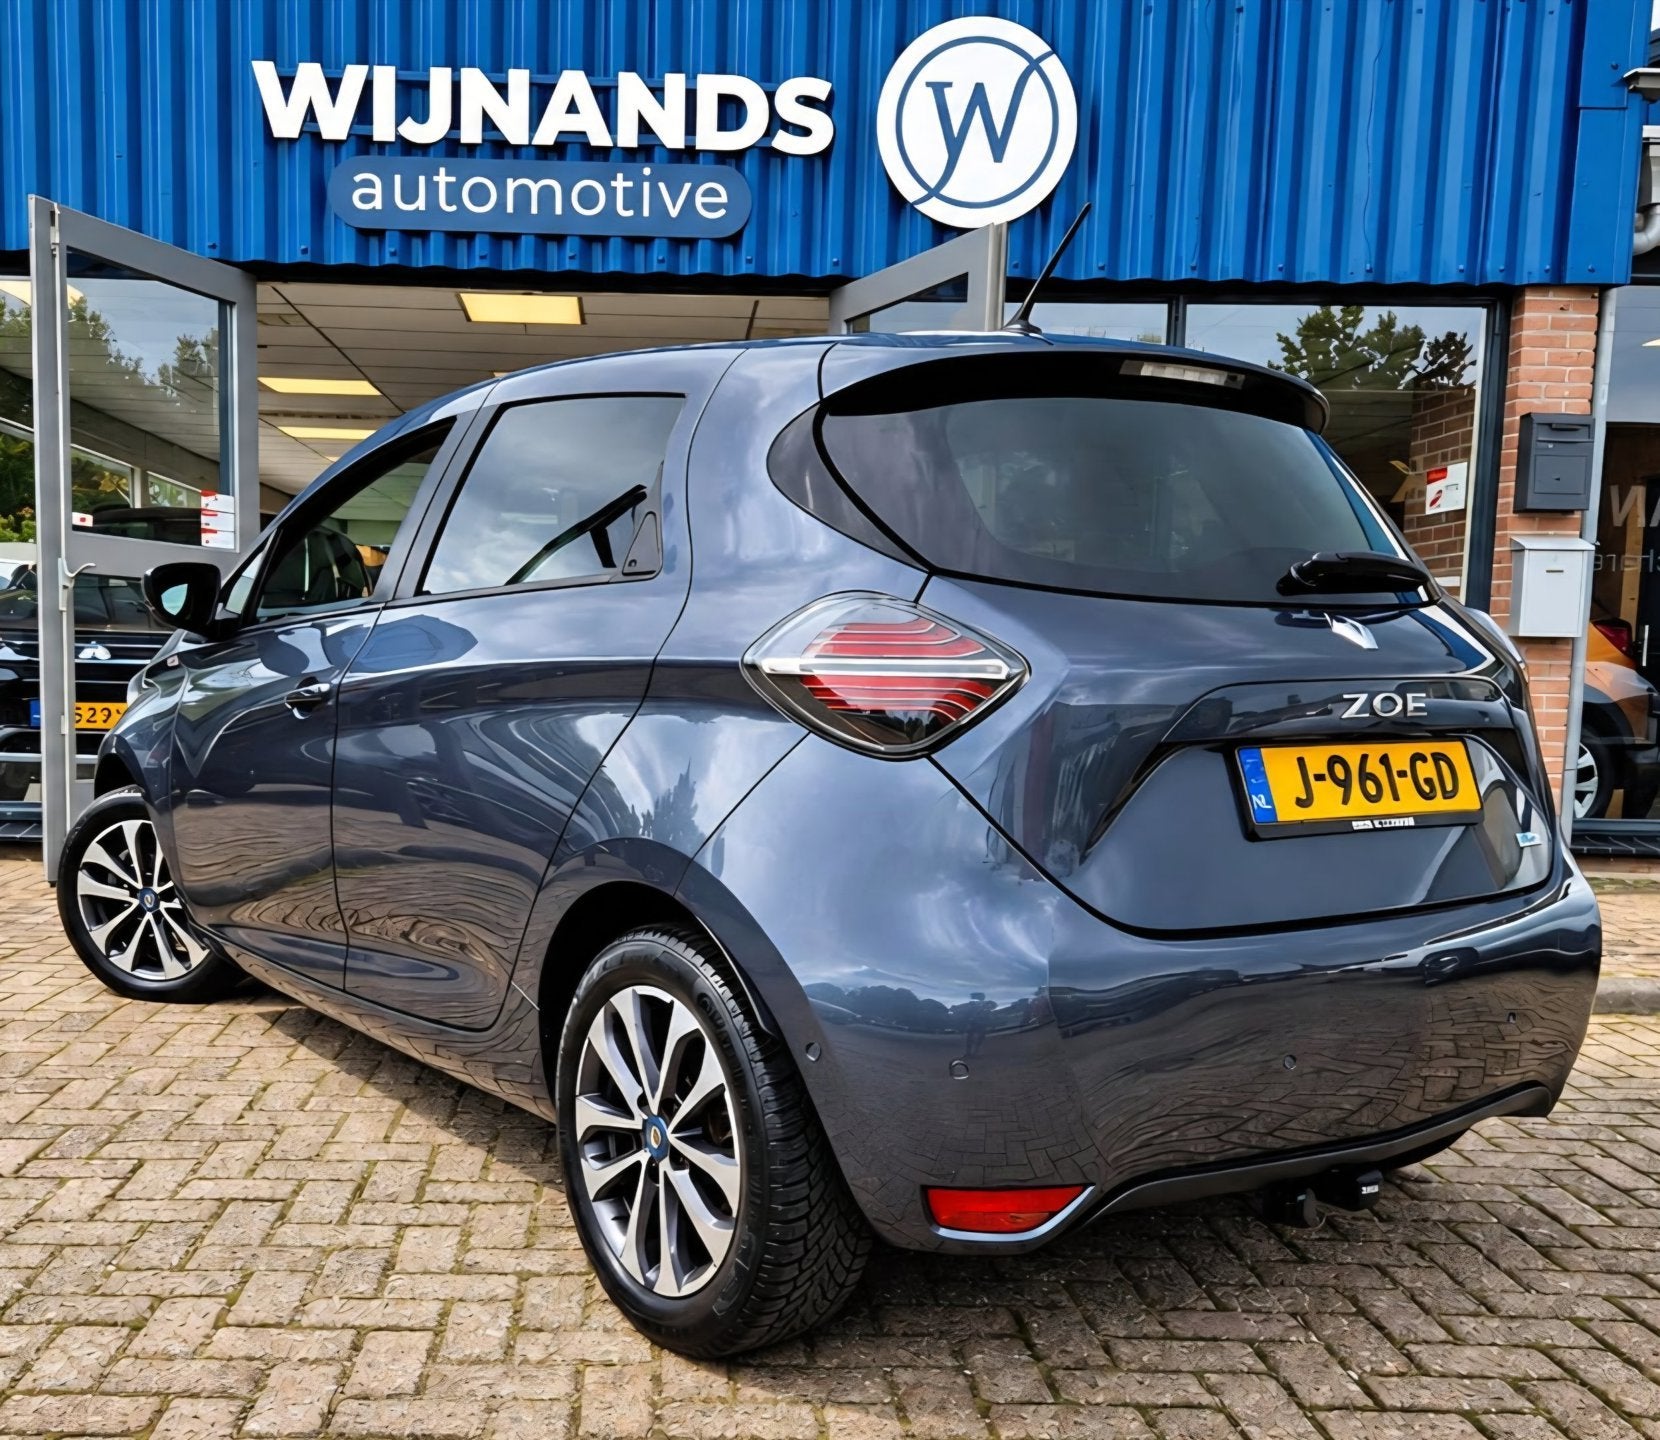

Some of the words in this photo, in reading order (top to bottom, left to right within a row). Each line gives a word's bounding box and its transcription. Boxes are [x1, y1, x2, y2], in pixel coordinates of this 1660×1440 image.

[251, 60, 834, 155] WIJNANDS
[351, 165, 729, 220] automotive
[1341, 692, 1428, 720] ZOE
[1295, 751, 1459, 809] J-961-GD
